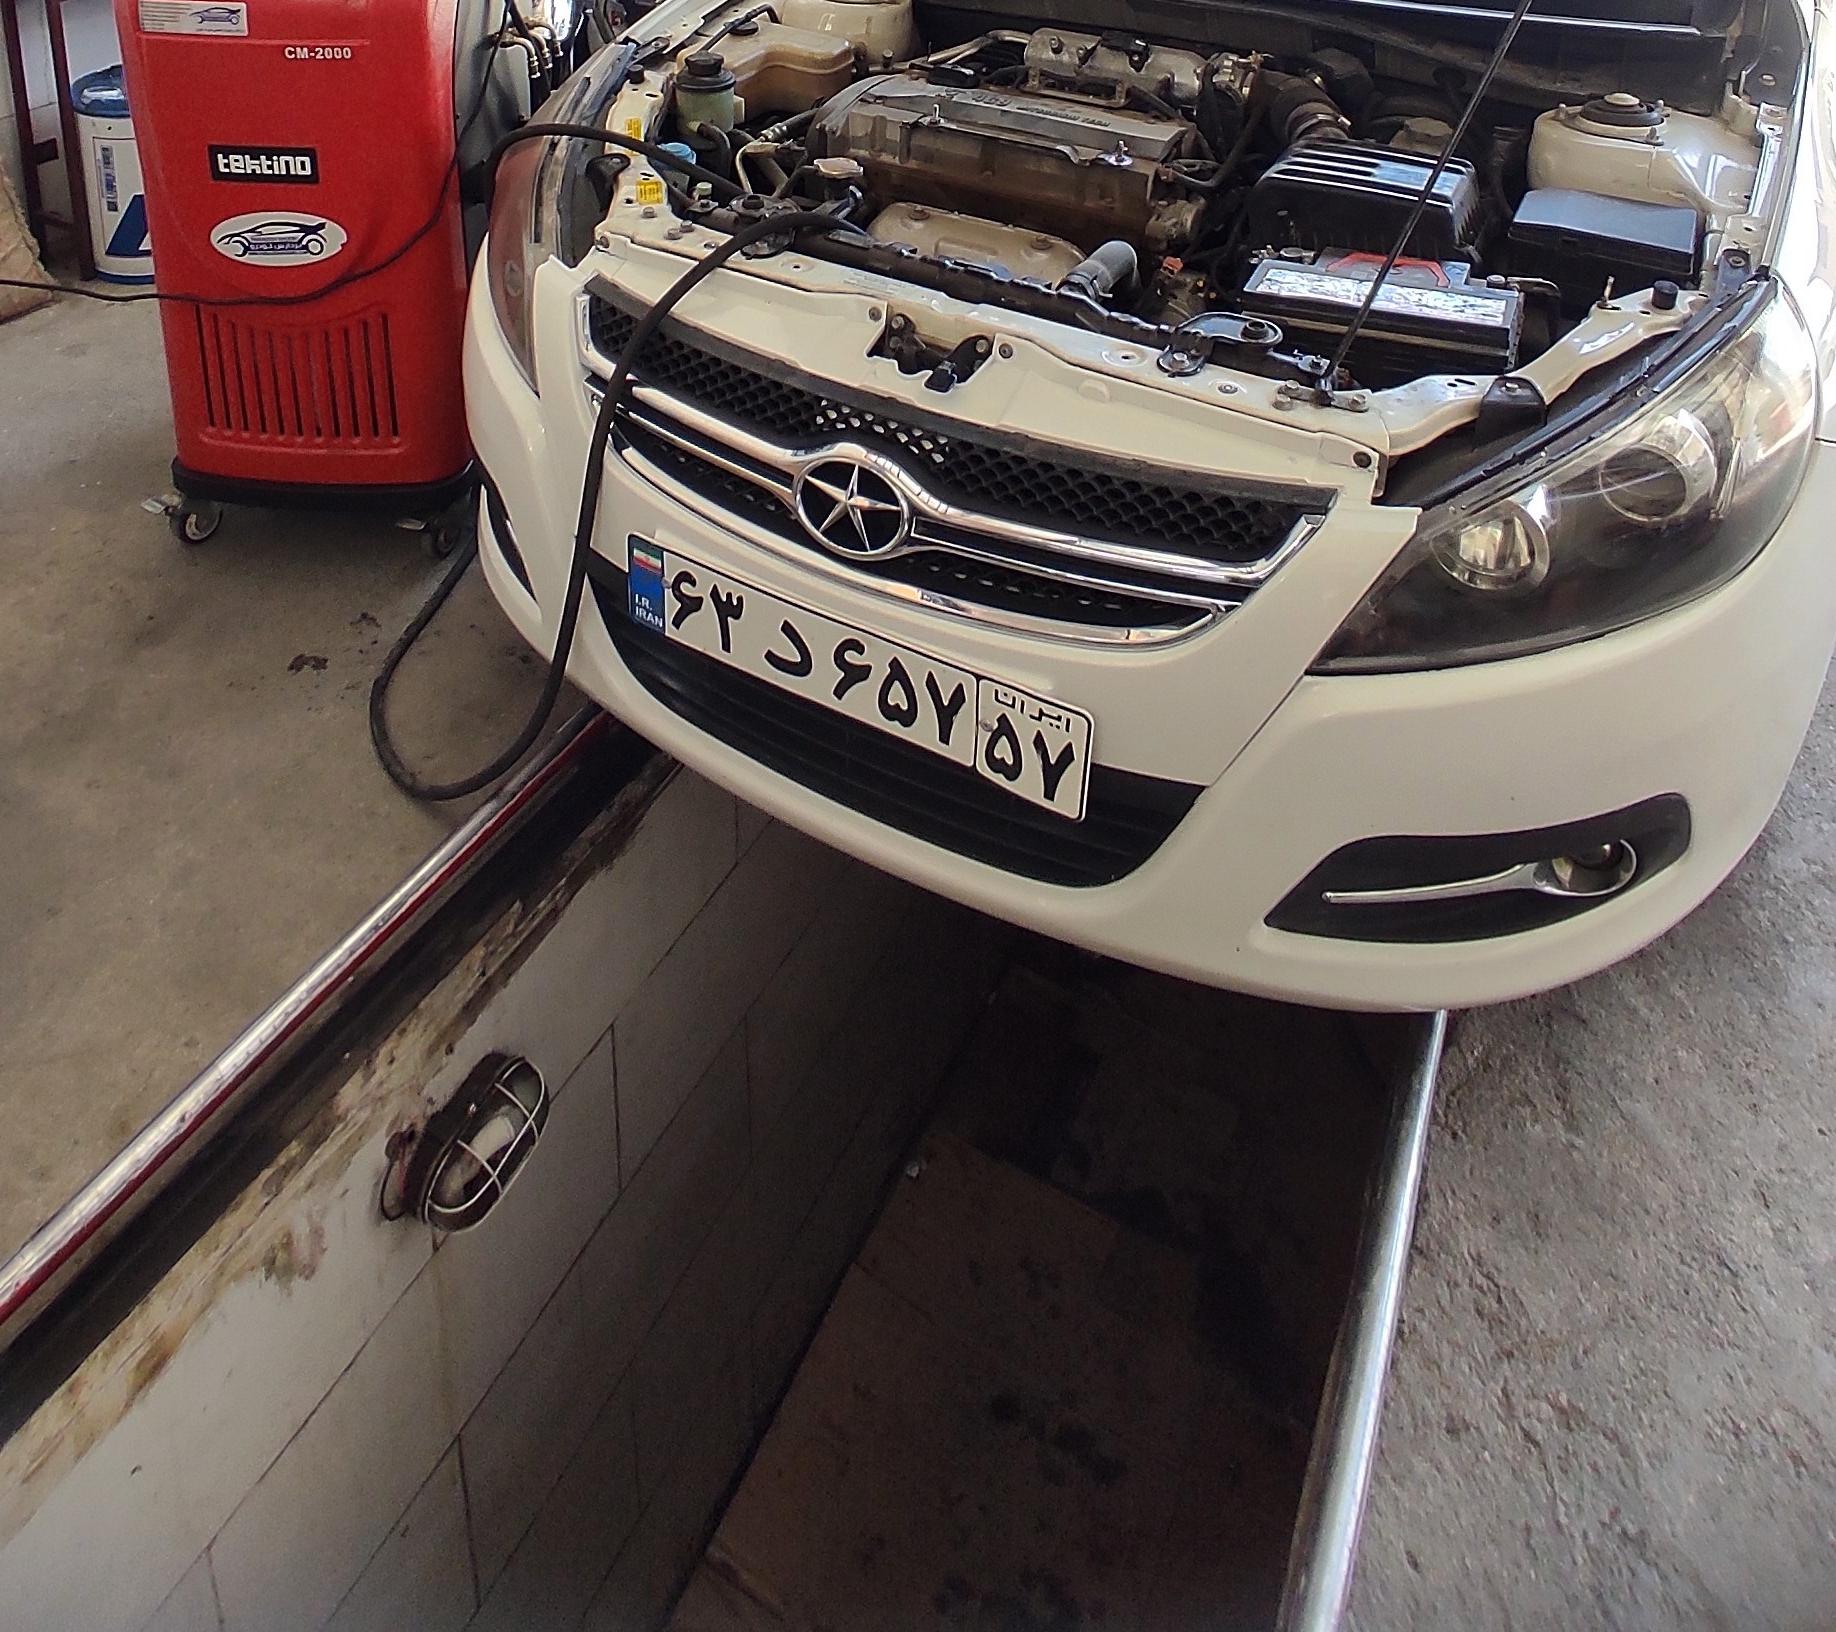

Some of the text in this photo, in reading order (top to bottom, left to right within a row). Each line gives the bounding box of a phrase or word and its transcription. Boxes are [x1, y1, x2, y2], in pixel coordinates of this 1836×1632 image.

[284, 46, 352, 60] CM-2000
[635, 593, 653, 611] I.R.
[635, 605, 663, 628] IRAN
[994, 688, 1071, 734] ایران
[984, 713, 1075, 802] ۵۷
